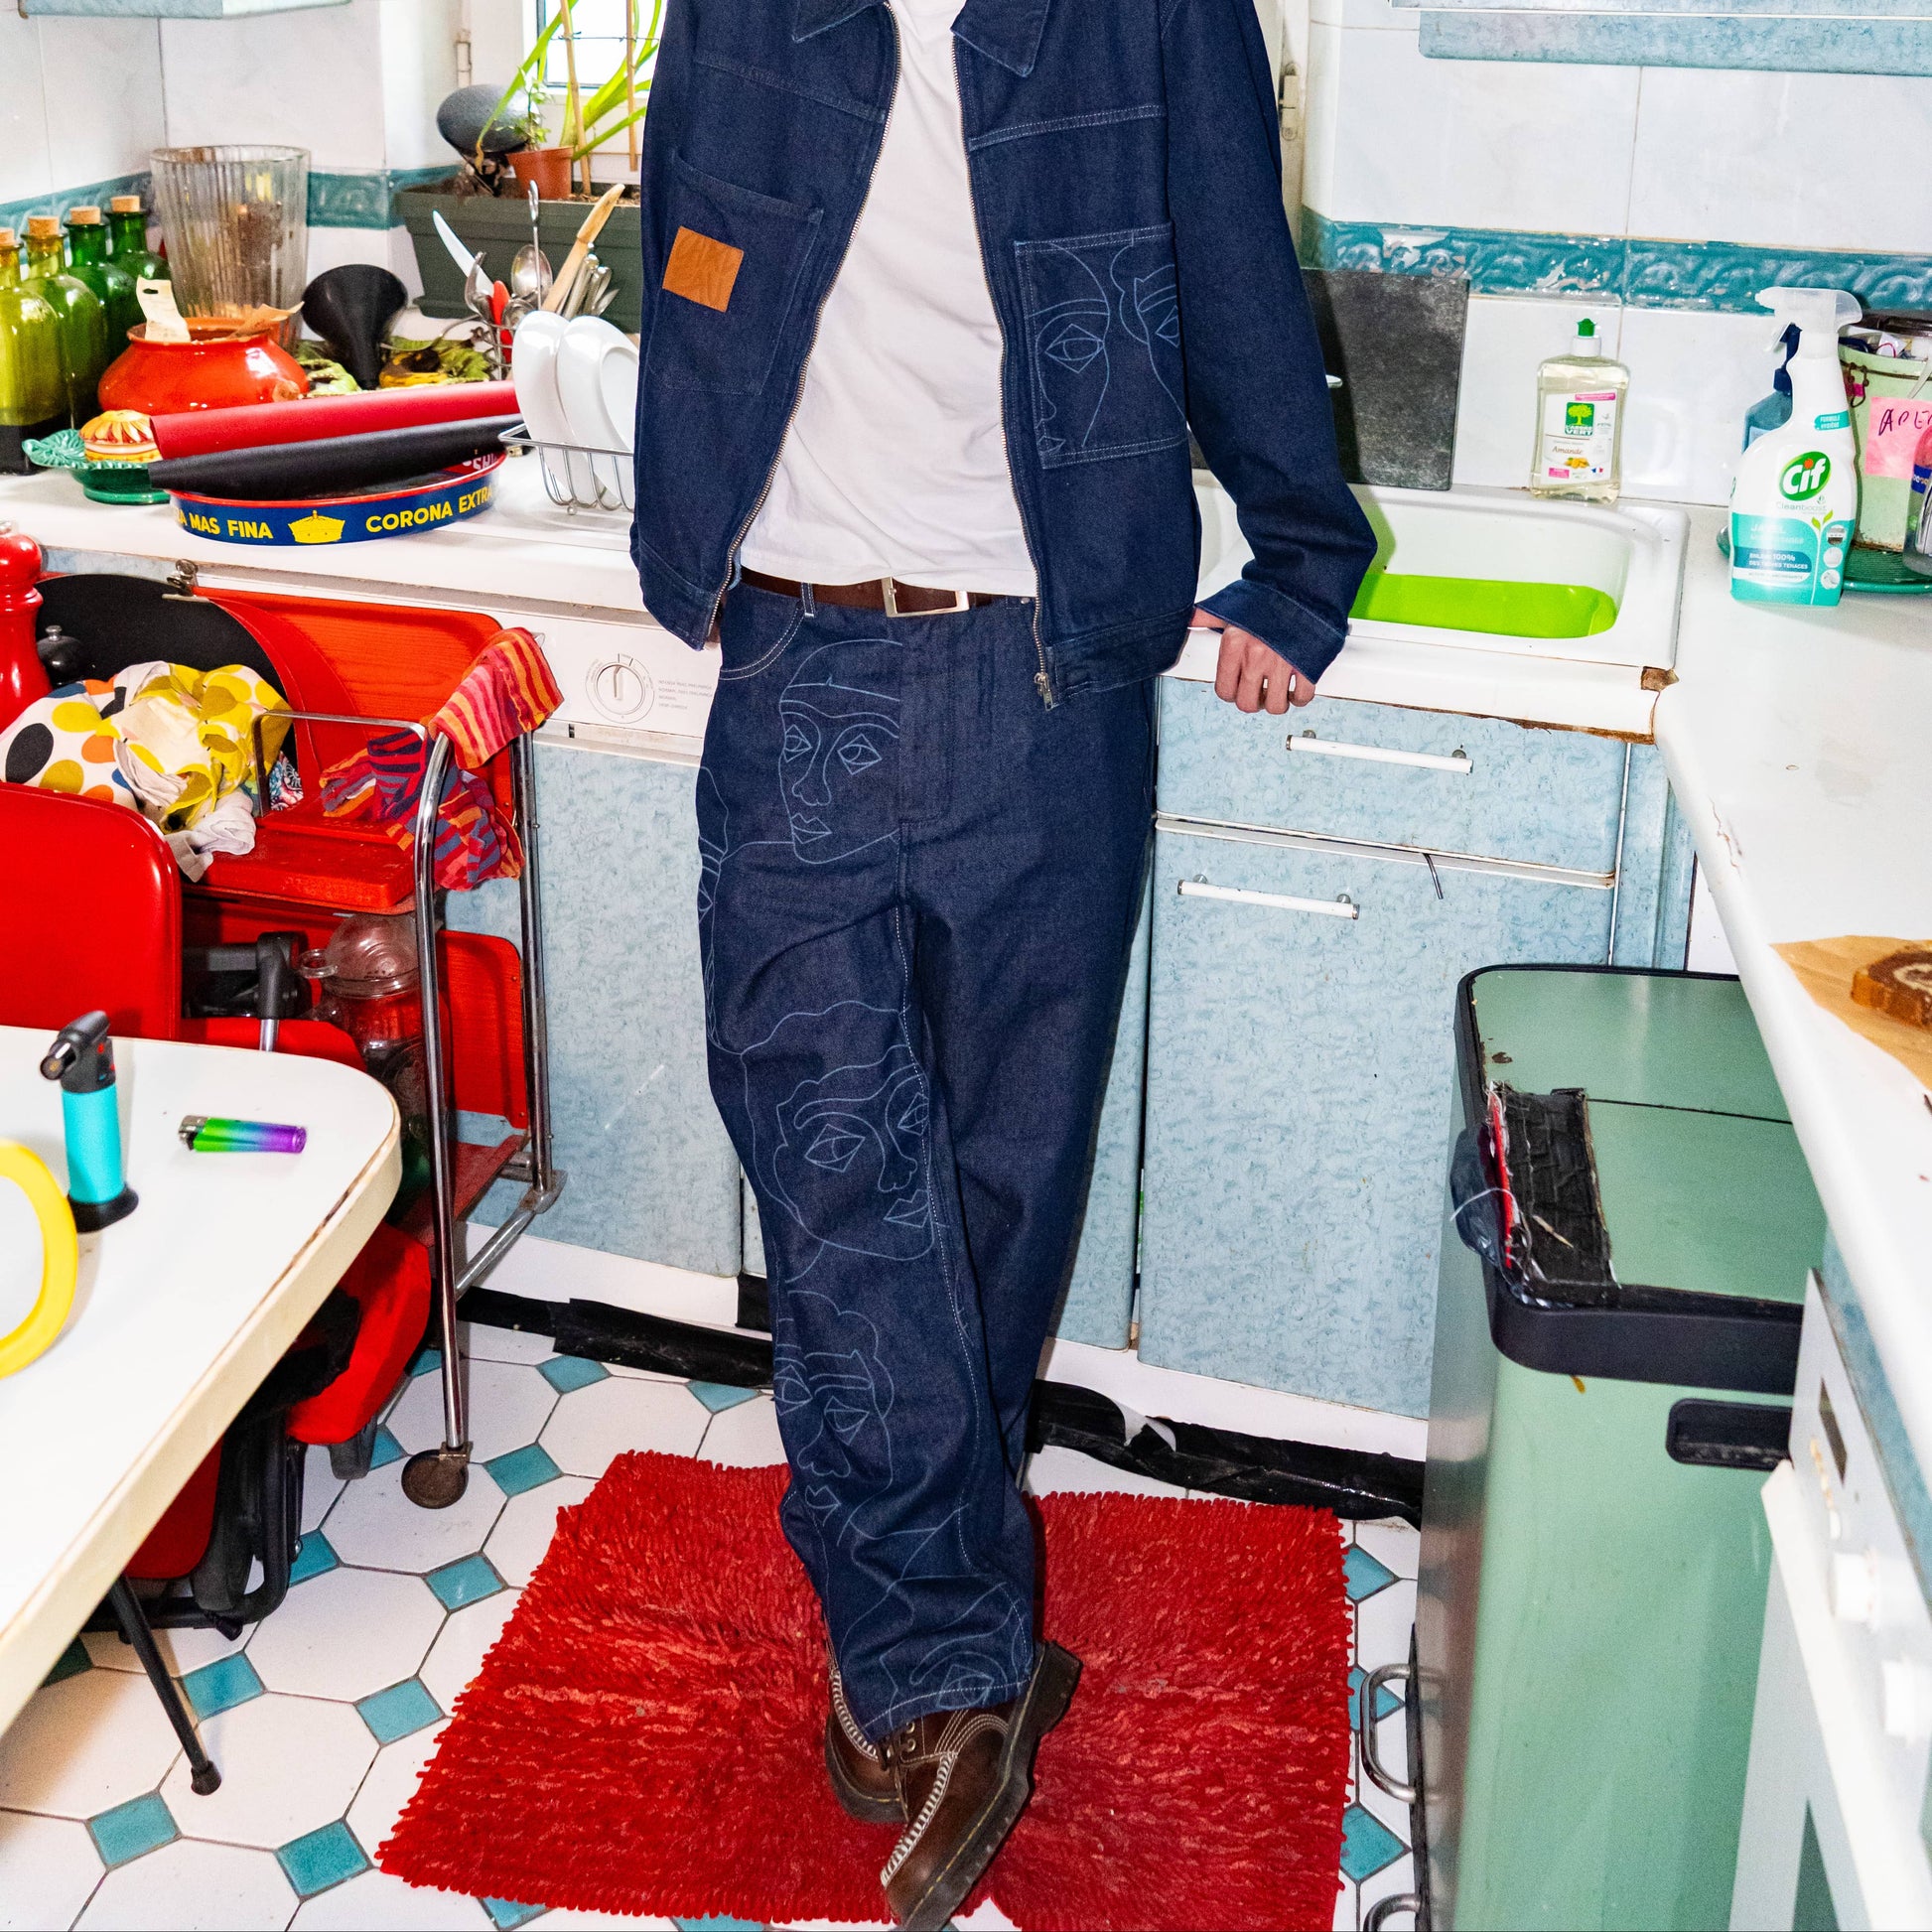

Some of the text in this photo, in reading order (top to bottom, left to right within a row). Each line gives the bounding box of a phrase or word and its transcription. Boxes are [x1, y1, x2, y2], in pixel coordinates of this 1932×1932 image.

[1552, 446, 1583, 455] Amande
[1782, 458, 1826, 494] Cif
[189, 512, 220, 534] MAS
[226, 519, 274, 539] FINA
[365, 501, 453, 533] CORONA
[1772, 552, 1796, 562] 100%
